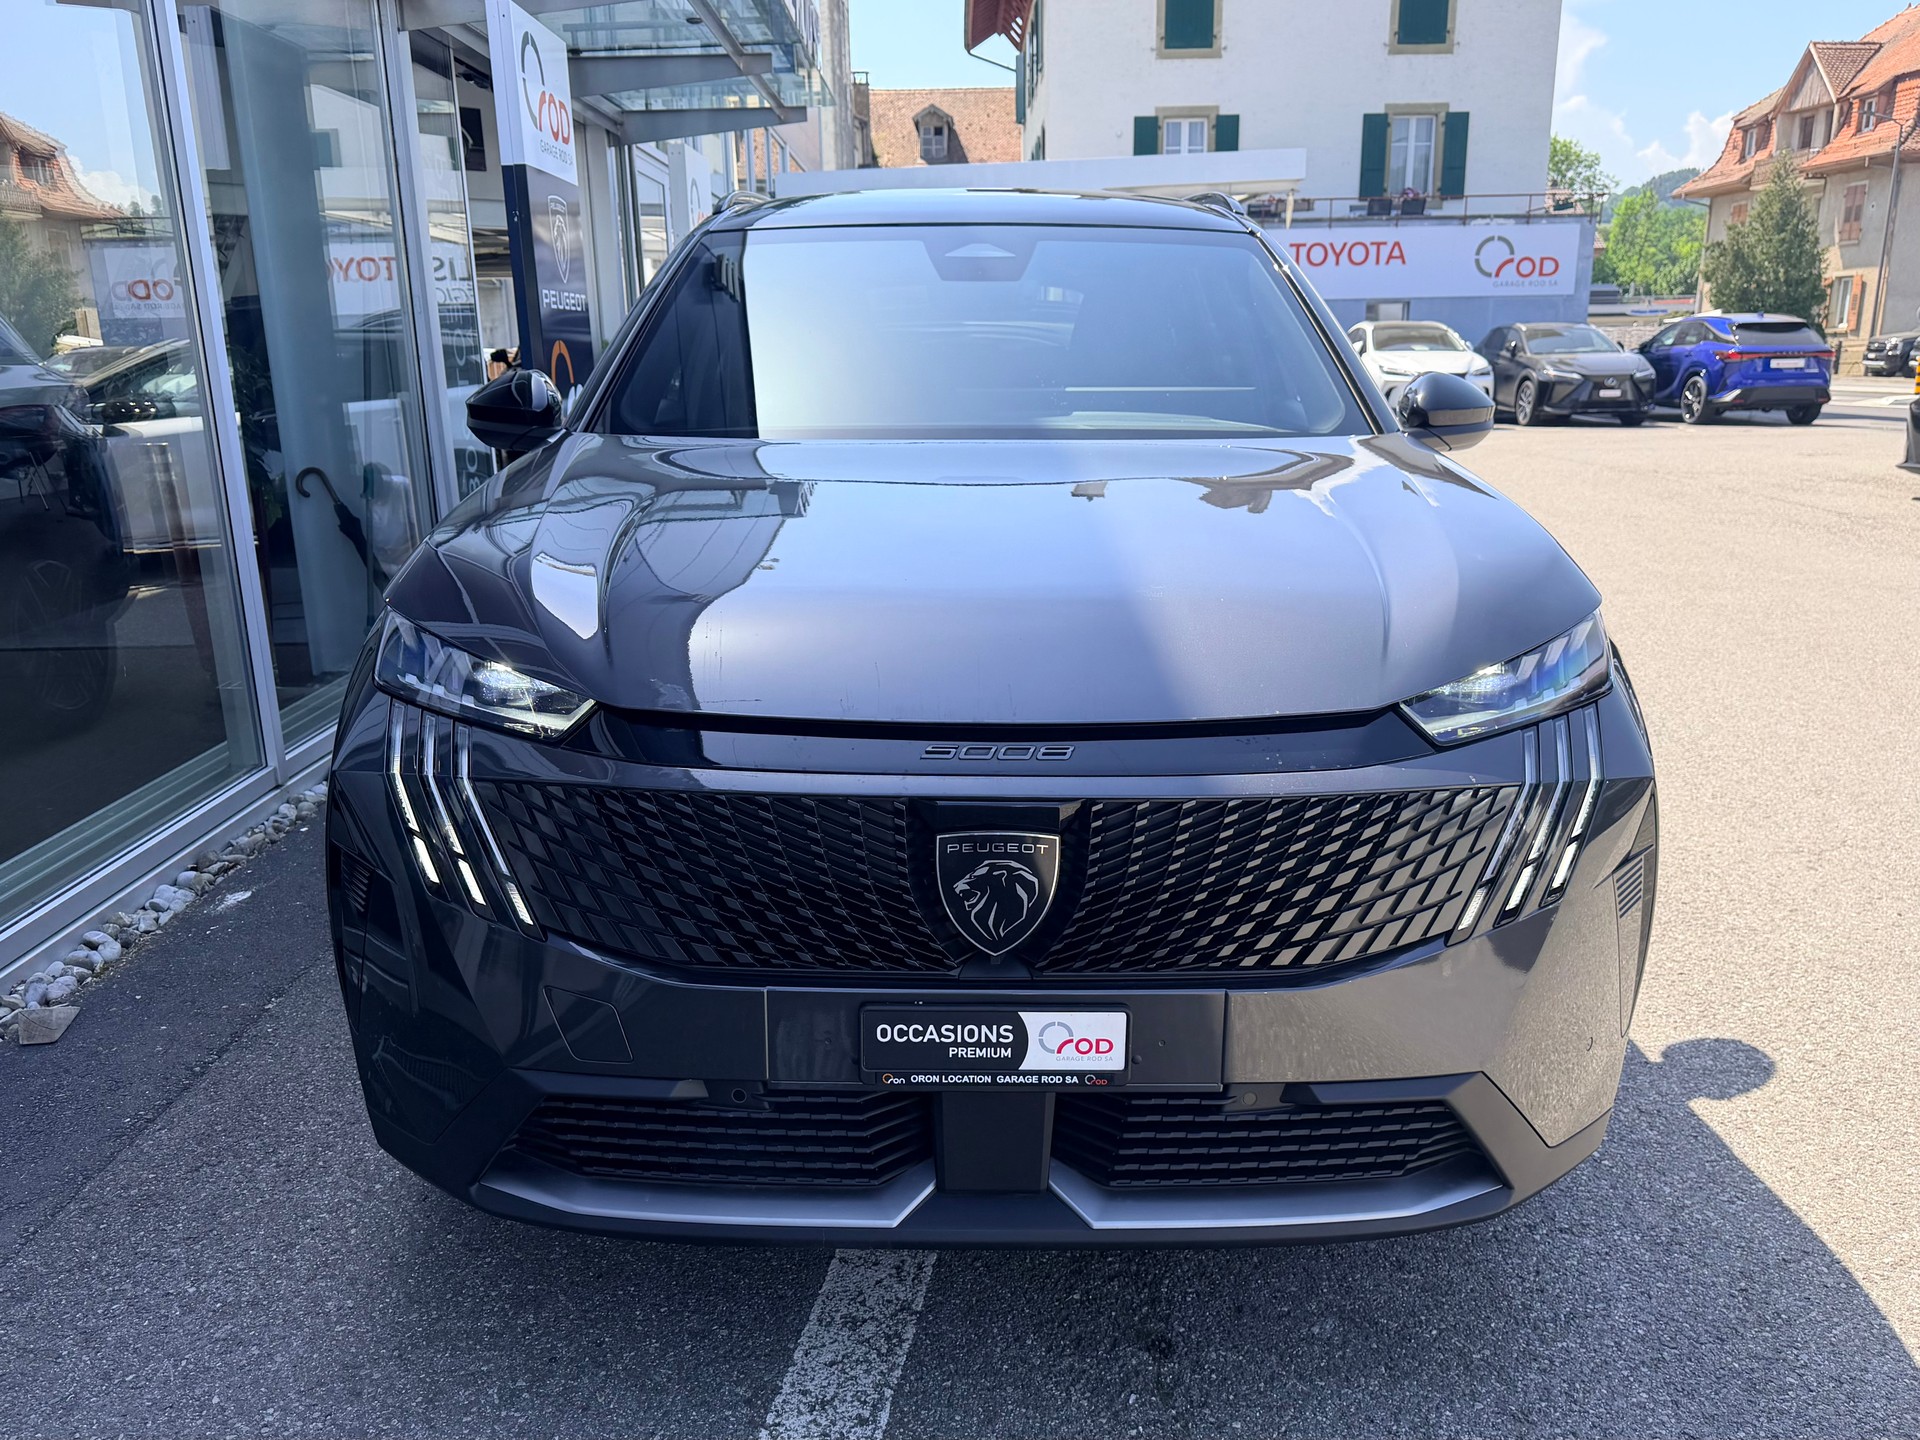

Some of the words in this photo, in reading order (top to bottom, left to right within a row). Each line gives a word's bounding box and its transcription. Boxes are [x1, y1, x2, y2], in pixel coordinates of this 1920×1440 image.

[1290, 241, 1406, 267] TOYOTA
[542, 289, 586, 311] PEUGEOT
[920, 744, 1075, 761] 5008
[947, 843, 1049, 854] PEUGEOT
[876, 1024, 1014, 1043] OCCASIONS
[949, 1047, 1011, 1058] PREMIUM
[910, 1074, 940, 1083] ORON
[942, 1075, 991, 1083] LOCATION
[996, 1075, 1039, 1084] GARAGE
[1041, 1075, 1062, 1084] ROD
[1065, 1075, 1079, 1083] SA
